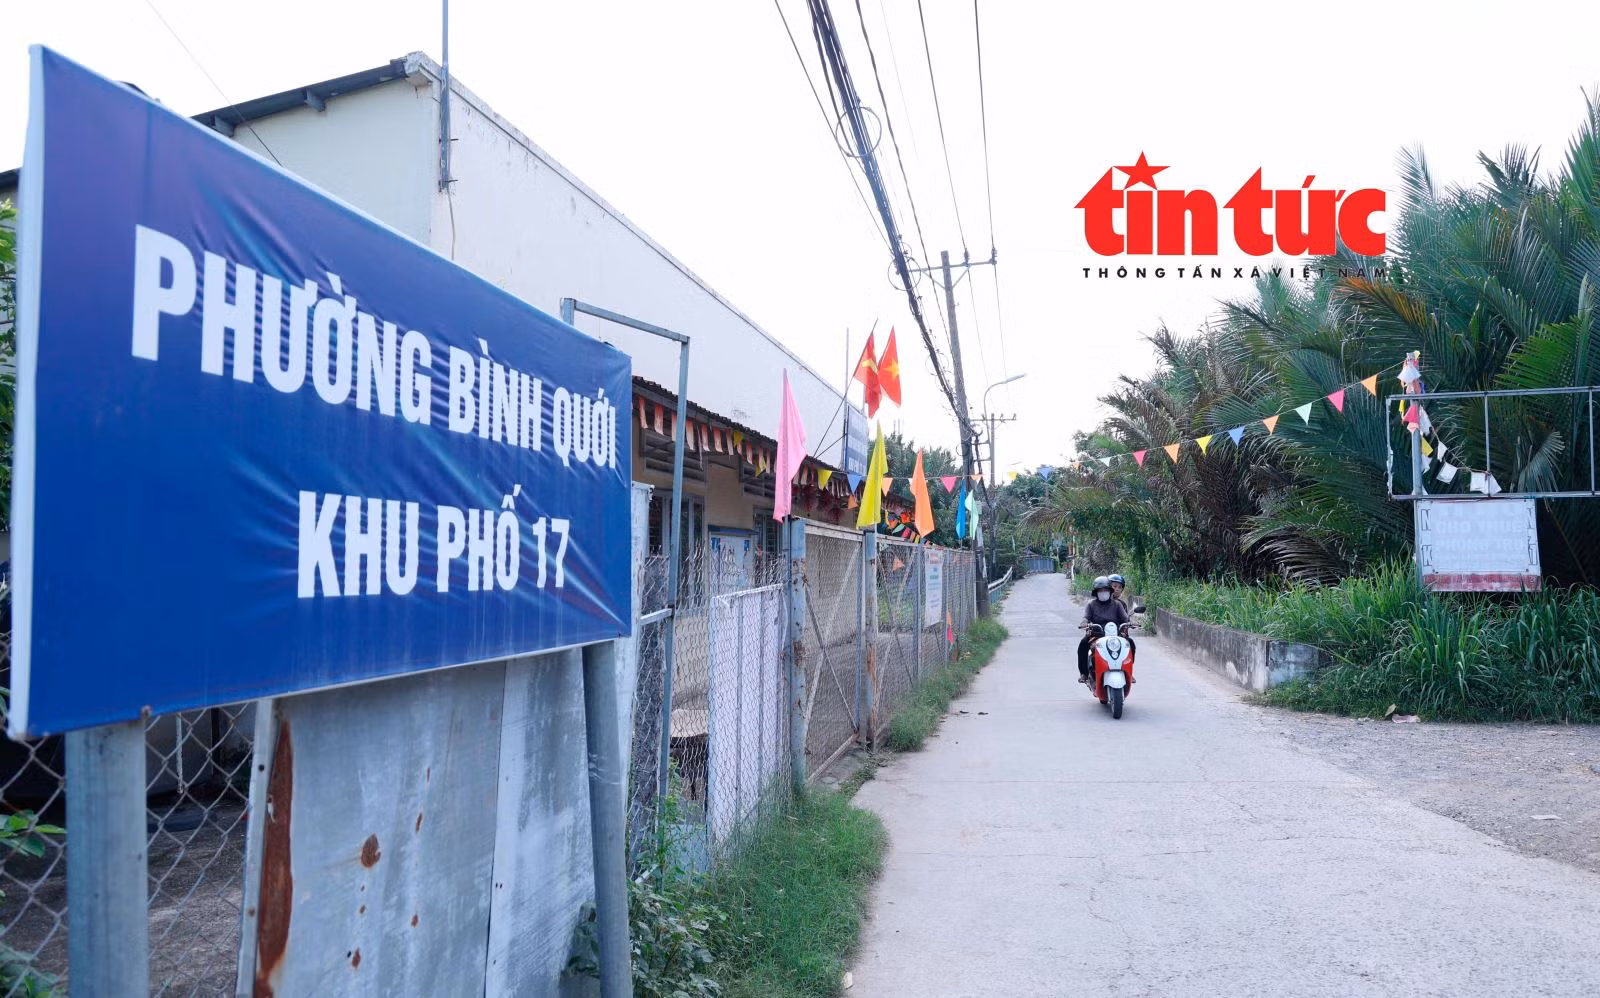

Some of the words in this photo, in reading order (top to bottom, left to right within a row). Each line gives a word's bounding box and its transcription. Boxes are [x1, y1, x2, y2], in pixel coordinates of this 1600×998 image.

[131, 223, 432, 425] PHƯỜNG
[448, 337, 542, 451] BÌNH
[553, 387, 616, 469] QUỚI
[298, 490, 419, 598] KHU
[436, 484, 520, 592] PHỐ
[532, 517, 570, 588] 17
